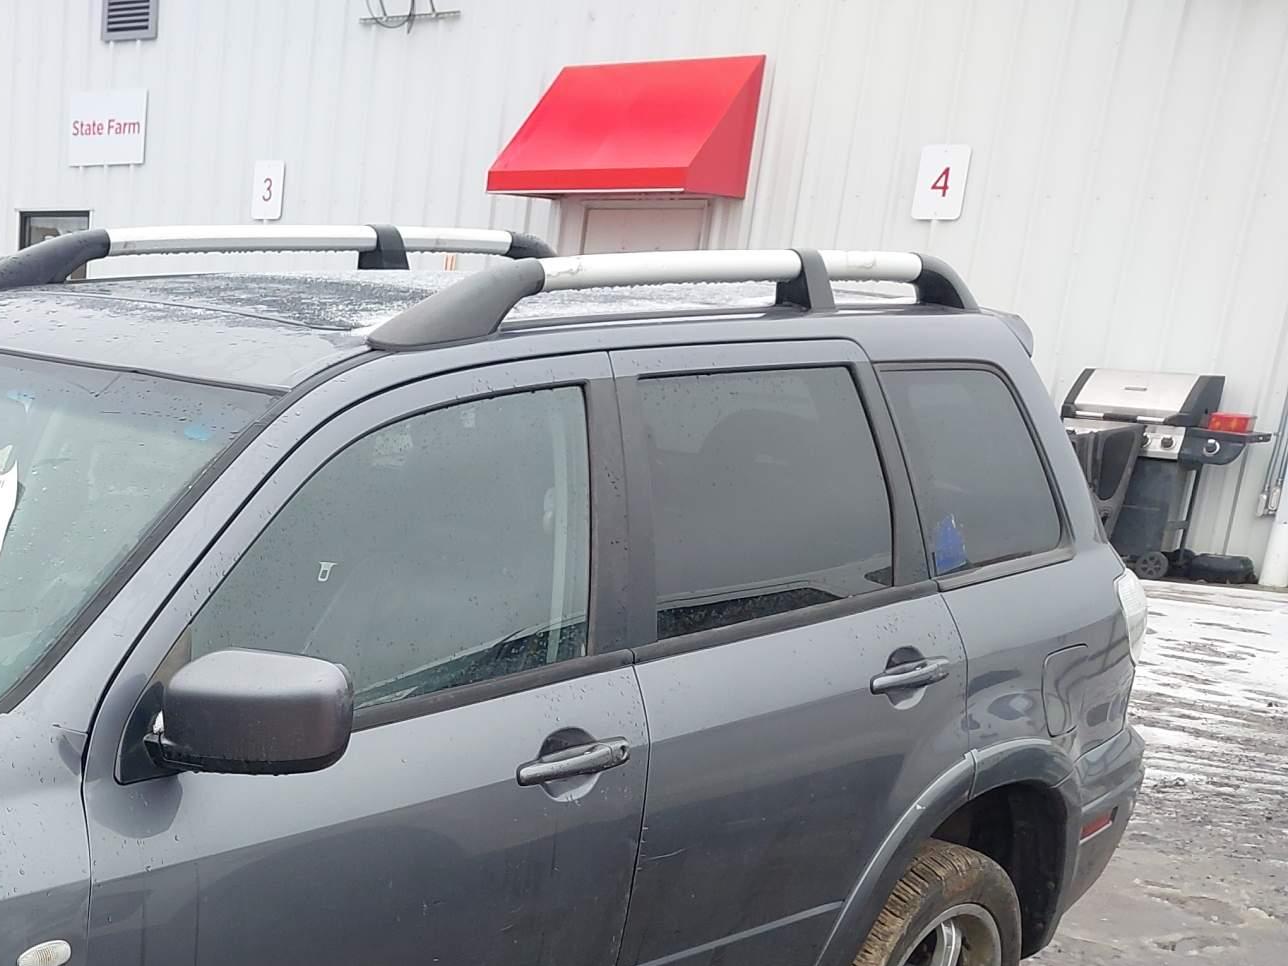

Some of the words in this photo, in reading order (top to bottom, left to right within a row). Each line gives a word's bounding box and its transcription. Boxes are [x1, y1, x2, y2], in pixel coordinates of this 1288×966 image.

[72, 120, 104, 136] State
[107, 119, 140, 135] Farm
[262, 178, 272, 202] 3
[931, 166, 950, 197] 4
